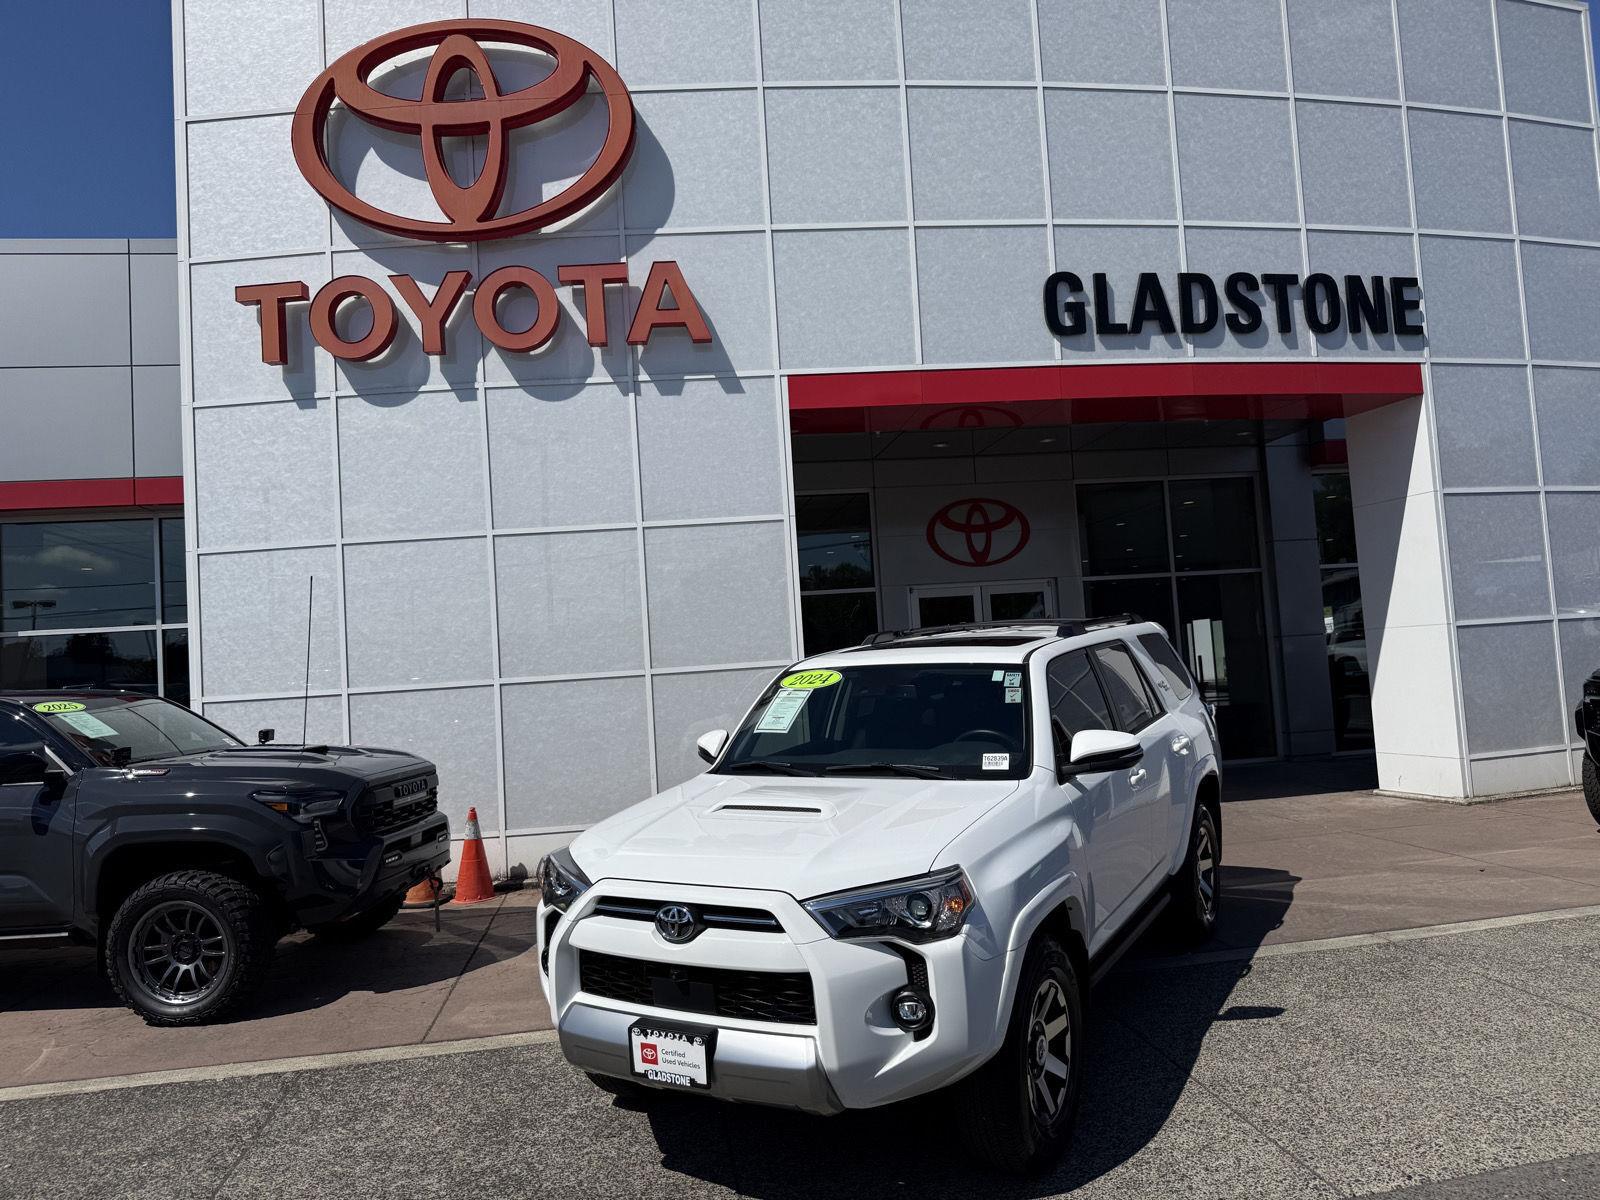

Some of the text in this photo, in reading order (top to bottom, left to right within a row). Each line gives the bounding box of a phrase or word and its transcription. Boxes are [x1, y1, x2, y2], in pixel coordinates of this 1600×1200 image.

[1043, 271, 1424, 335] GLADSTONE
[235, 261, 713, 366] TOYOTA
[788, 673, 833, 686] 2024
[43, 703, 78, 711] 2025
[399, 780, 427, 797] TOYOTA
[646, 1029, 688, 1042] TOYOTA
[661, 1048, 686, 1058] Certified
[662, 1058, 700, 1070] Used Vehicles
[648, 1069, 690, 1086] GLADSTONE
